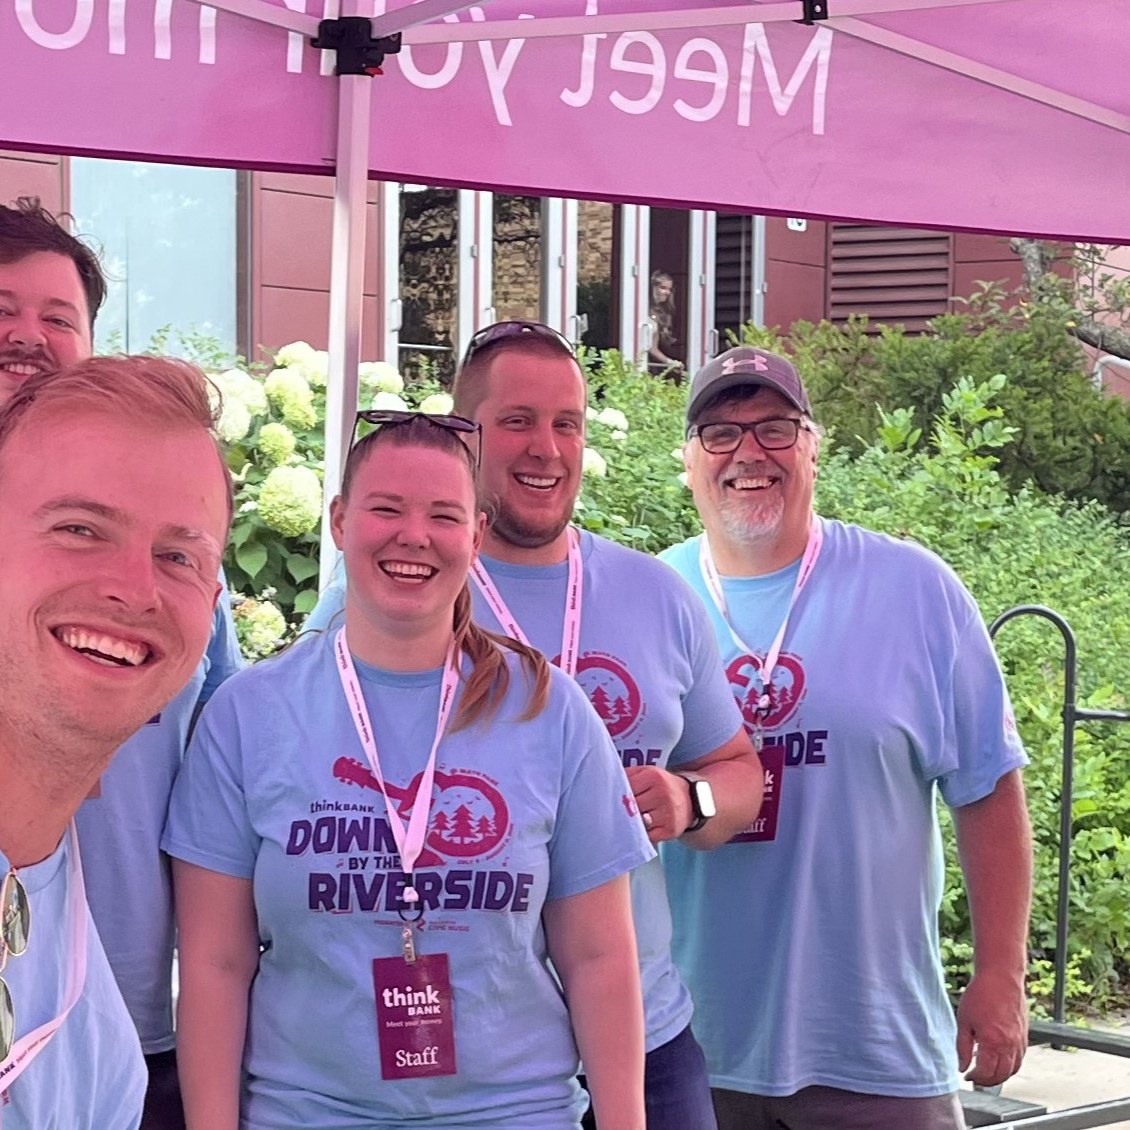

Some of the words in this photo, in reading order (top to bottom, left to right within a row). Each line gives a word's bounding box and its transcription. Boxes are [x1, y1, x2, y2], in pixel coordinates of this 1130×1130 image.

[310, 800, 375, 814] thinkBANK
[349, 857, 368, 870] BY
[309, 869, 534, 913] RIVERSIDE
[382, 984, 441, 1008] think
[408, 1005, 441, 1016] BANK
[386, 1020, 404, 1029] Meet
[396, 1046, 438, 1068] Staff
